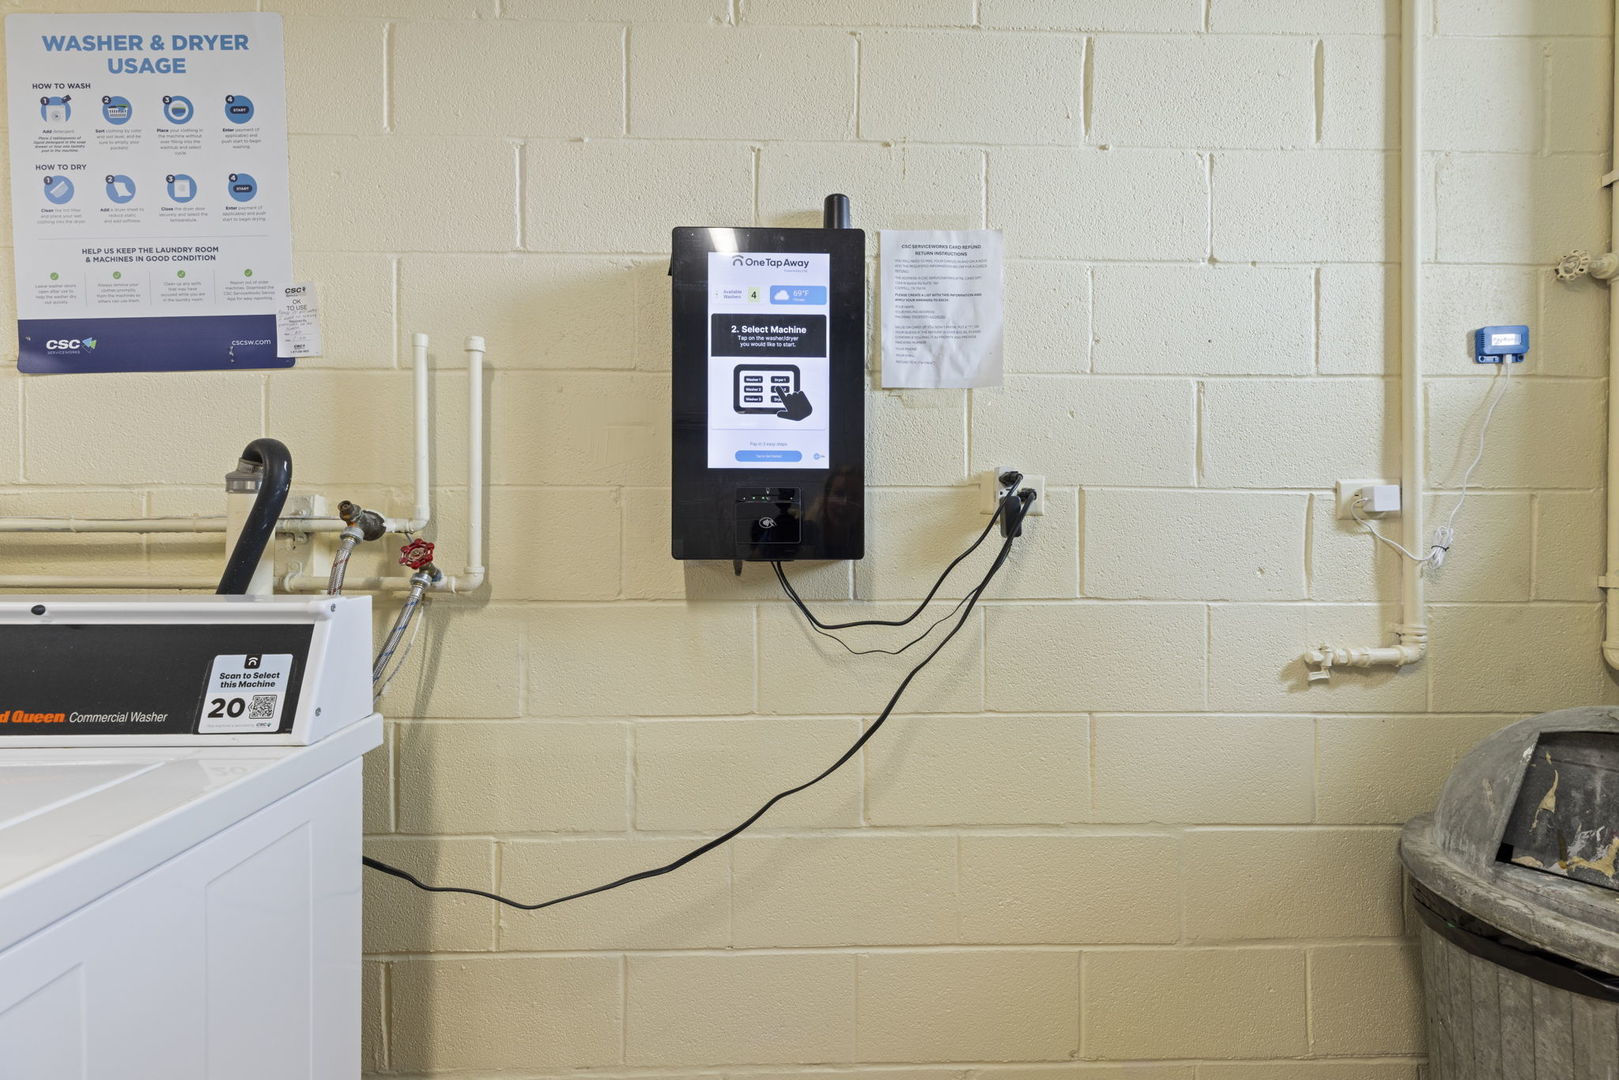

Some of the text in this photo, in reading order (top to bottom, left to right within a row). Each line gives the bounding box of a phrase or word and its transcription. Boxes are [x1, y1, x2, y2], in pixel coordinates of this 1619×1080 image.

[41, 34, 250, 52] WASHER & DRYER
[107, 58, 187, 74] USAGE
[745, 258, 810, 269] One Tap Away
[751, 291, 757, 299] 4
[771, 326, 807, 334] Machine
[46, 339, 81, 350] CSC
[232, 338, 272, 346] cscsw.com
[219, 672, 241, 680] Scan
[208, 697, 246, 718] 20
[12, 711, 65, 723] Queen
[69, 711, 168, 723] Commercial Washer
